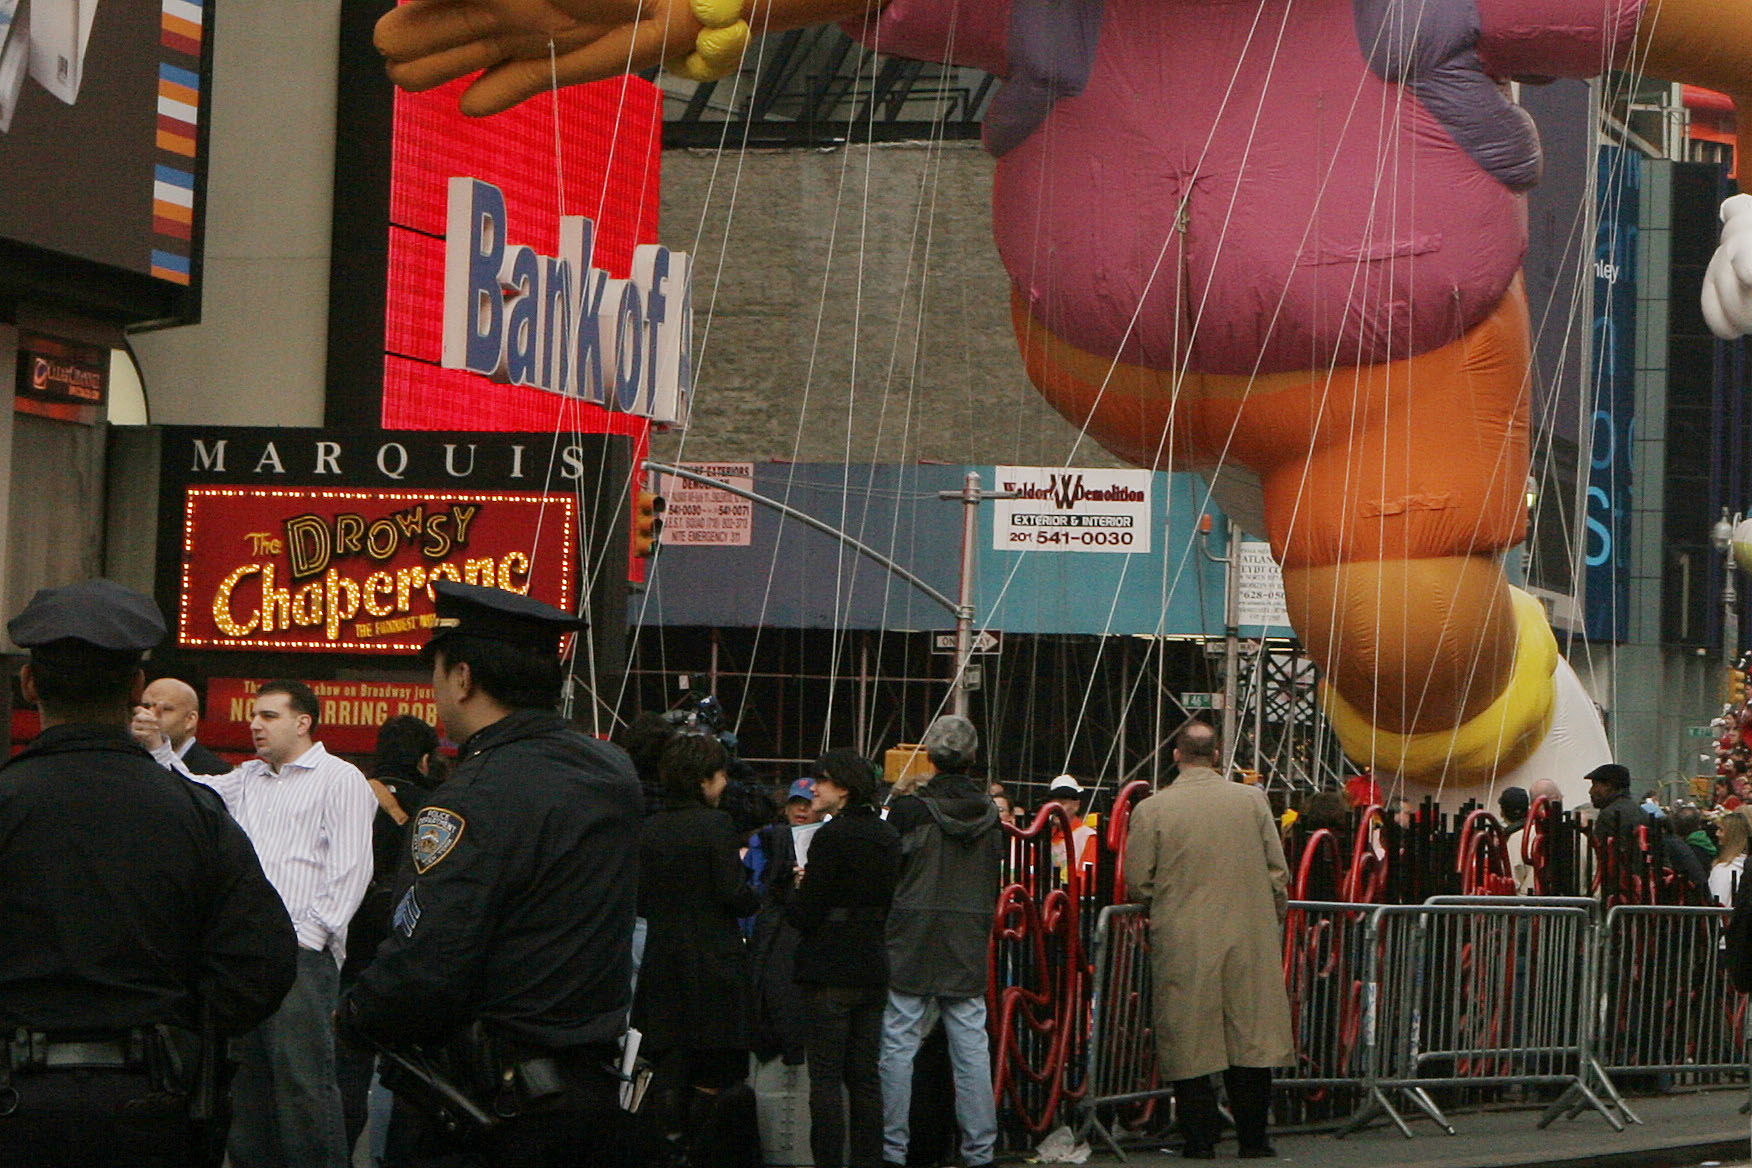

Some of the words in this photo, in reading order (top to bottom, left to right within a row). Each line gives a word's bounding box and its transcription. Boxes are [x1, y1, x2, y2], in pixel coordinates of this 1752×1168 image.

[442, 177, 607, 405] Bank
[607, 244, 669, 419] of
[191, 439, 584, 480] MARQUIS
[1074, 482, 1145, 502] Demolition
[1014, 515, 1067, 527] EXTERIOR
[1070, 515, 1079, 527] &
[1082, 516, 1131, 528] INTERIOR
[244, 532, 282, 557] The
[287, 502, 479, 578] DROWSY
[1037, 531, 1133, 545] 541-0030
[212, 552, 530, 640] Chaperone
[361, 684, 411, 701] Broadway
